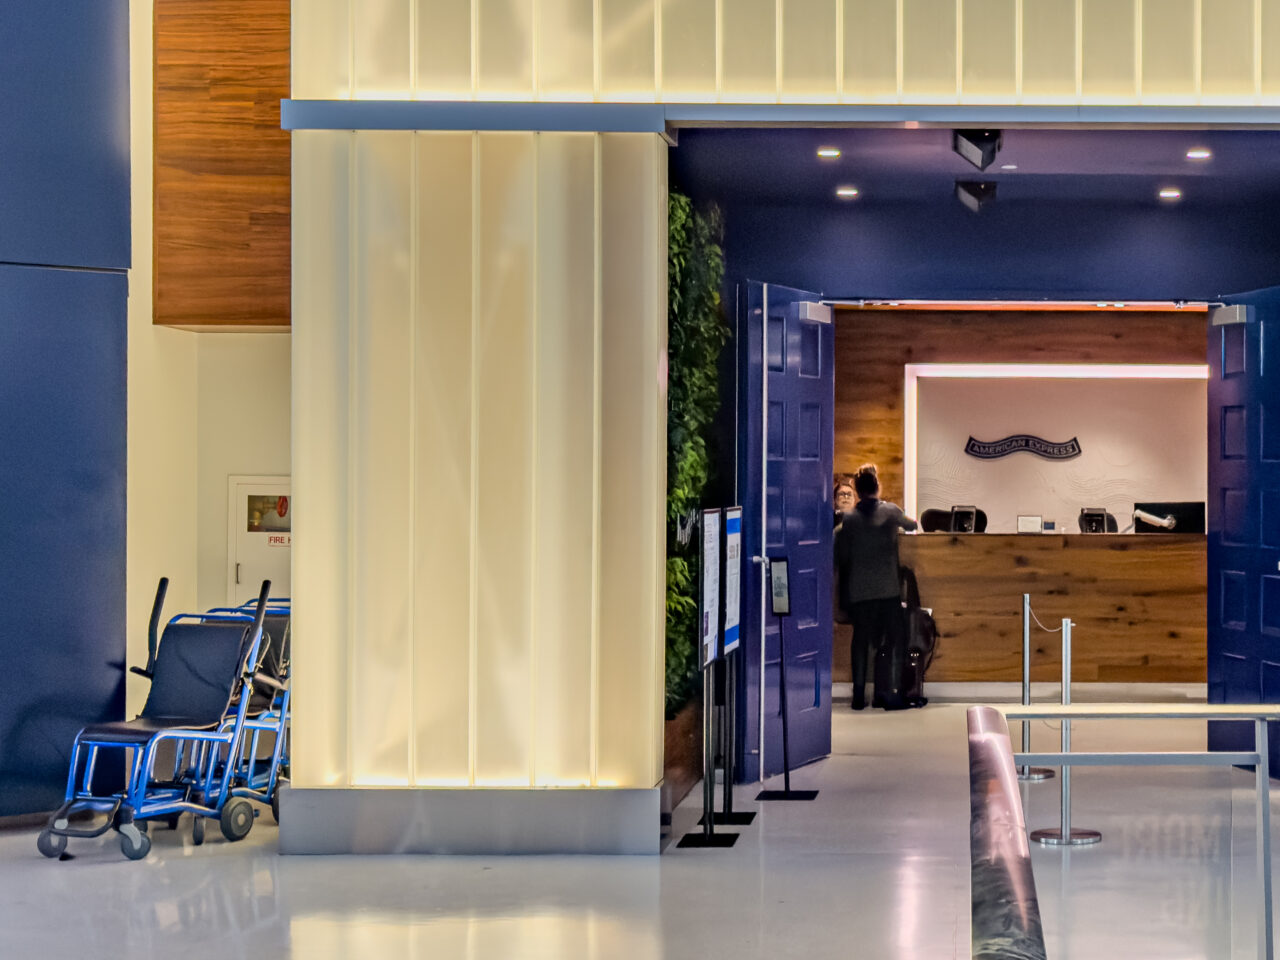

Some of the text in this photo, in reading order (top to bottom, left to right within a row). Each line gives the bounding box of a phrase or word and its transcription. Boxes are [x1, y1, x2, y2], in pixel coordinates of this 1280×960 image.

[973, 439, 1074, 456] AMERICAN EXPRESS
[269, 536, 285, 544] FIRE
